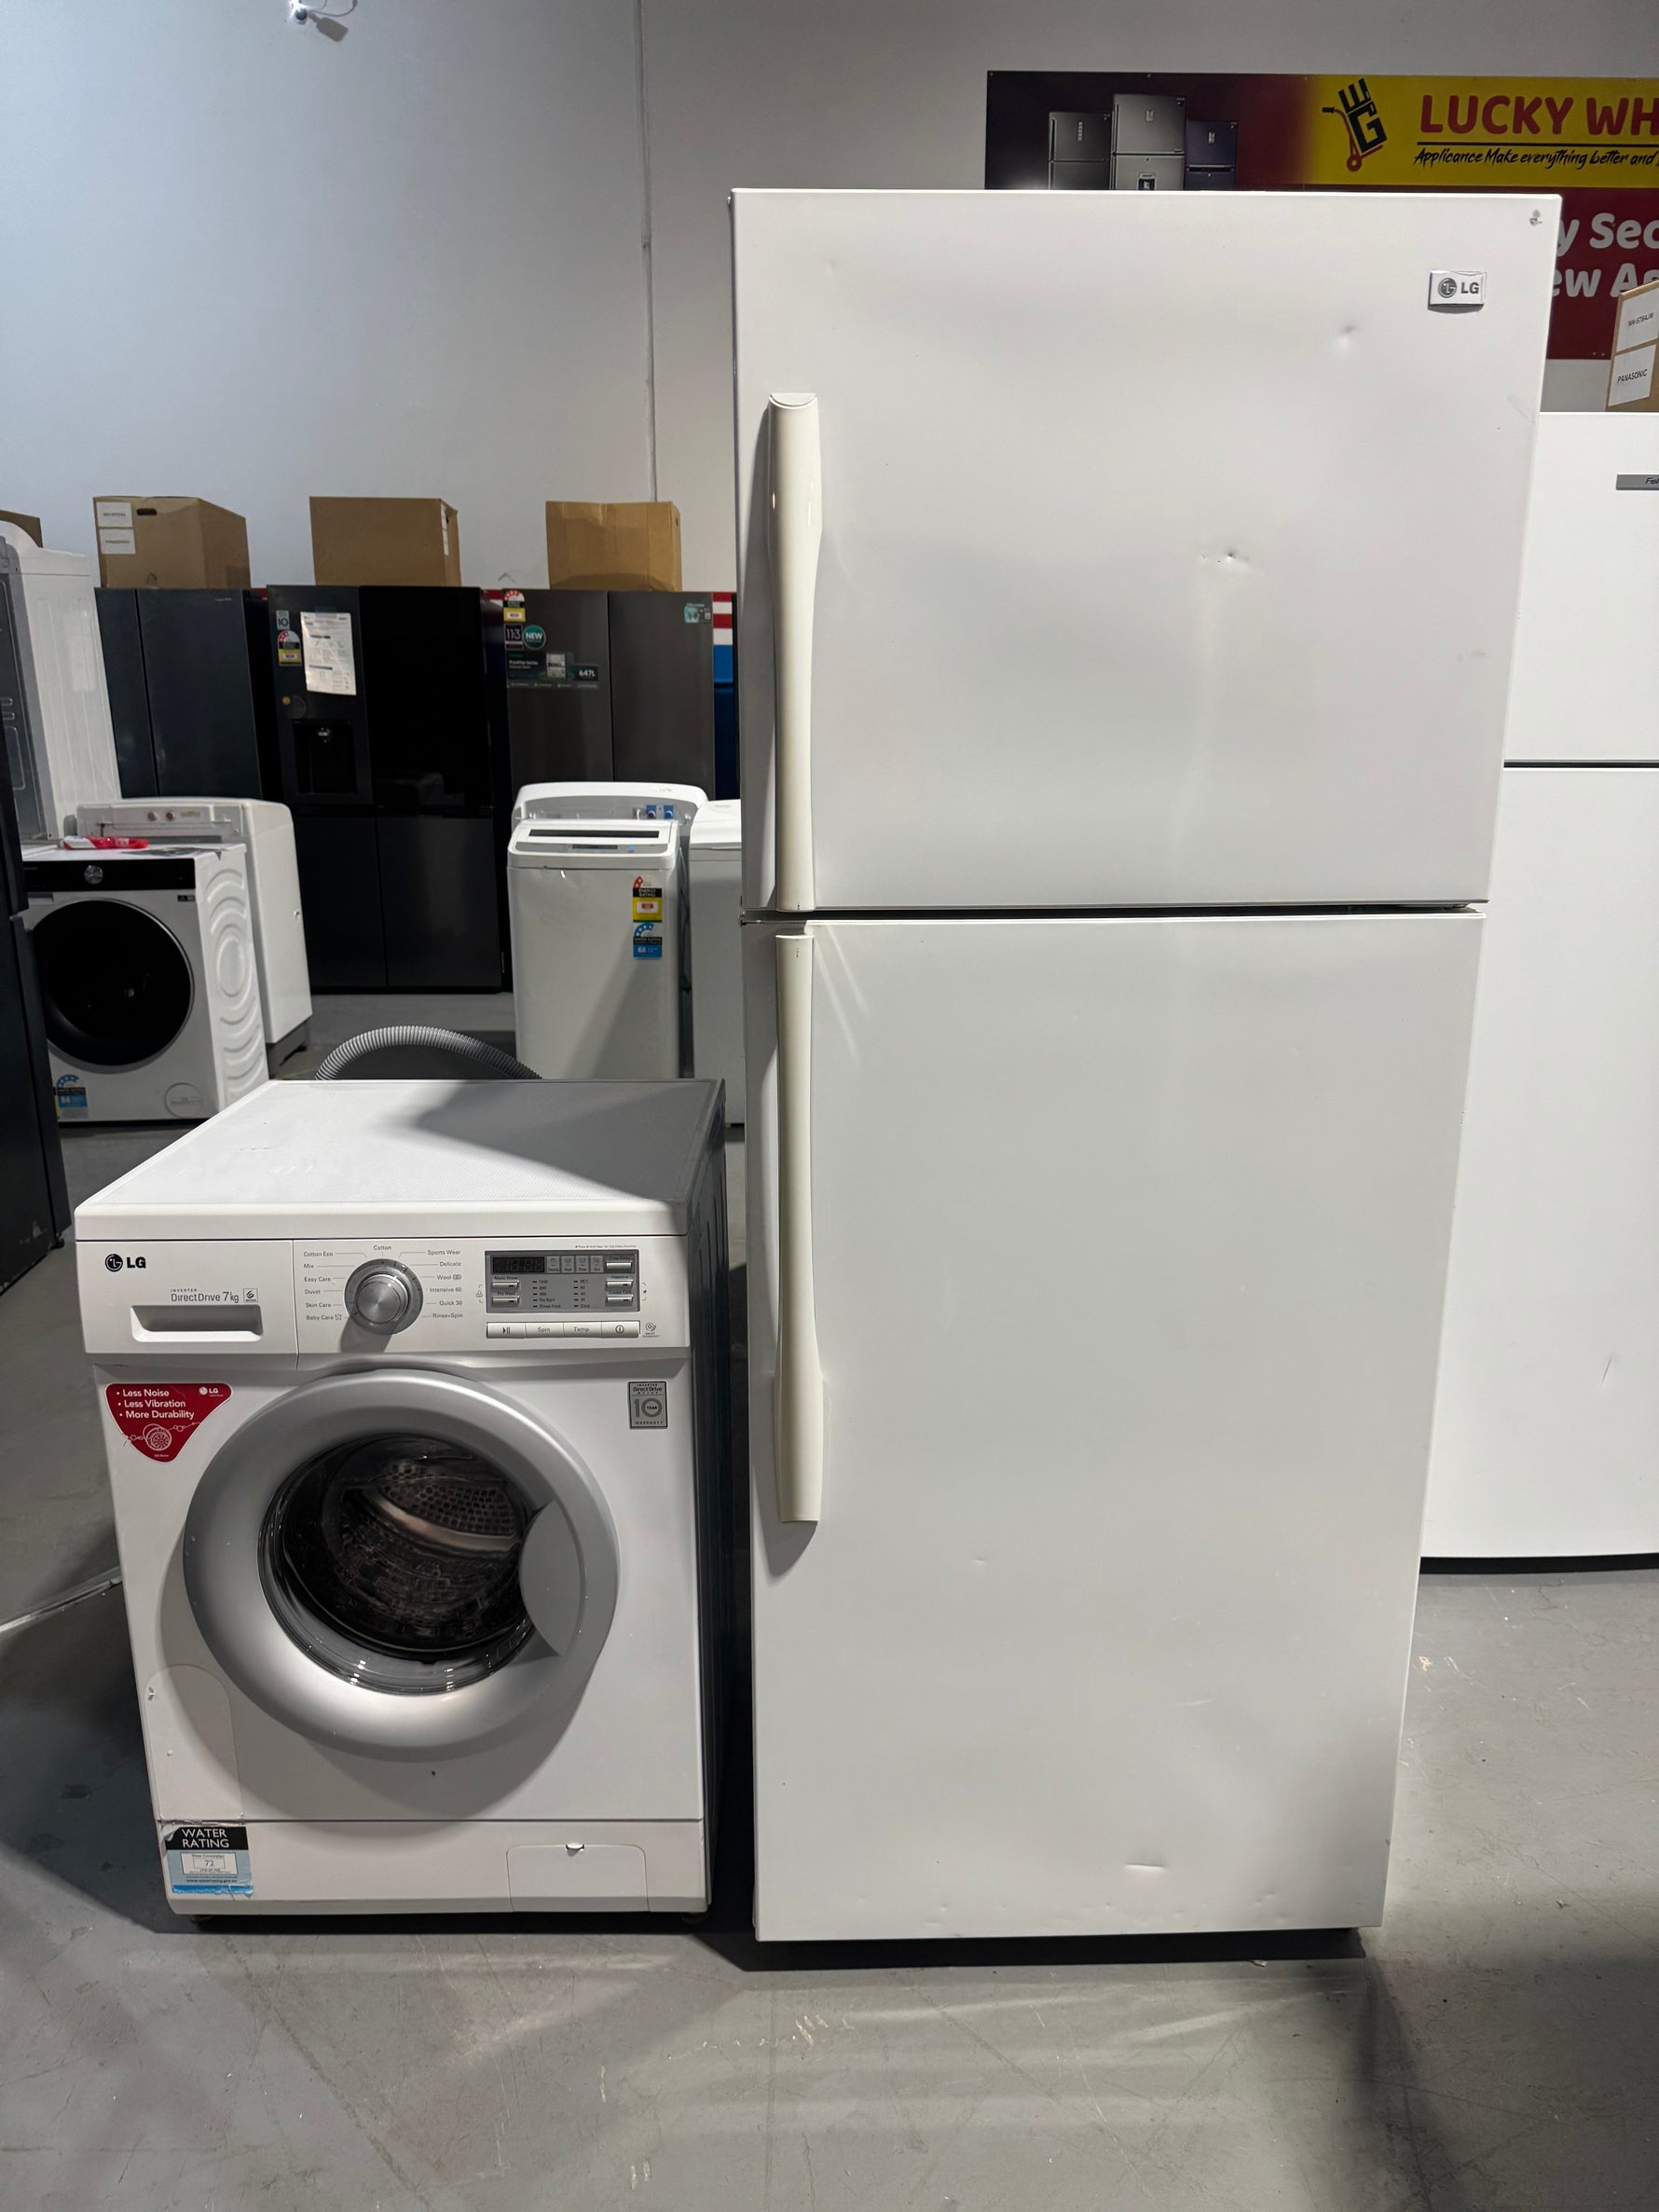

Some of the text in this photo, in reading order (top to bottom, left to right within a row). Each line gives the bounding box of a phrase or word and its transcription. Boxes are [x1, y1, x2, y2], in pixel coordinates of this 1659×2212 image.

[1419, 94, 1574, 135] LUCKY
[1413, 147, 1657, 170] Applicance Make everything better and
[1460, 282, 1480, 295] LG
[1617, 368, 1648, 384] PANASONIC
[526, 632, 542, 640] NEW
[126, 1257, 146, 1269] LG
[123, 1389, 170, 1397] Less Noise
[144, 1399, 186, 1408] Vibration
[634, 1397, 663, 1418] 10
[125, 1409, 195, 1421] More Durability
[182, 1828, 227, 1838] WATER
[182, 1838, 229, 1848] RATING
